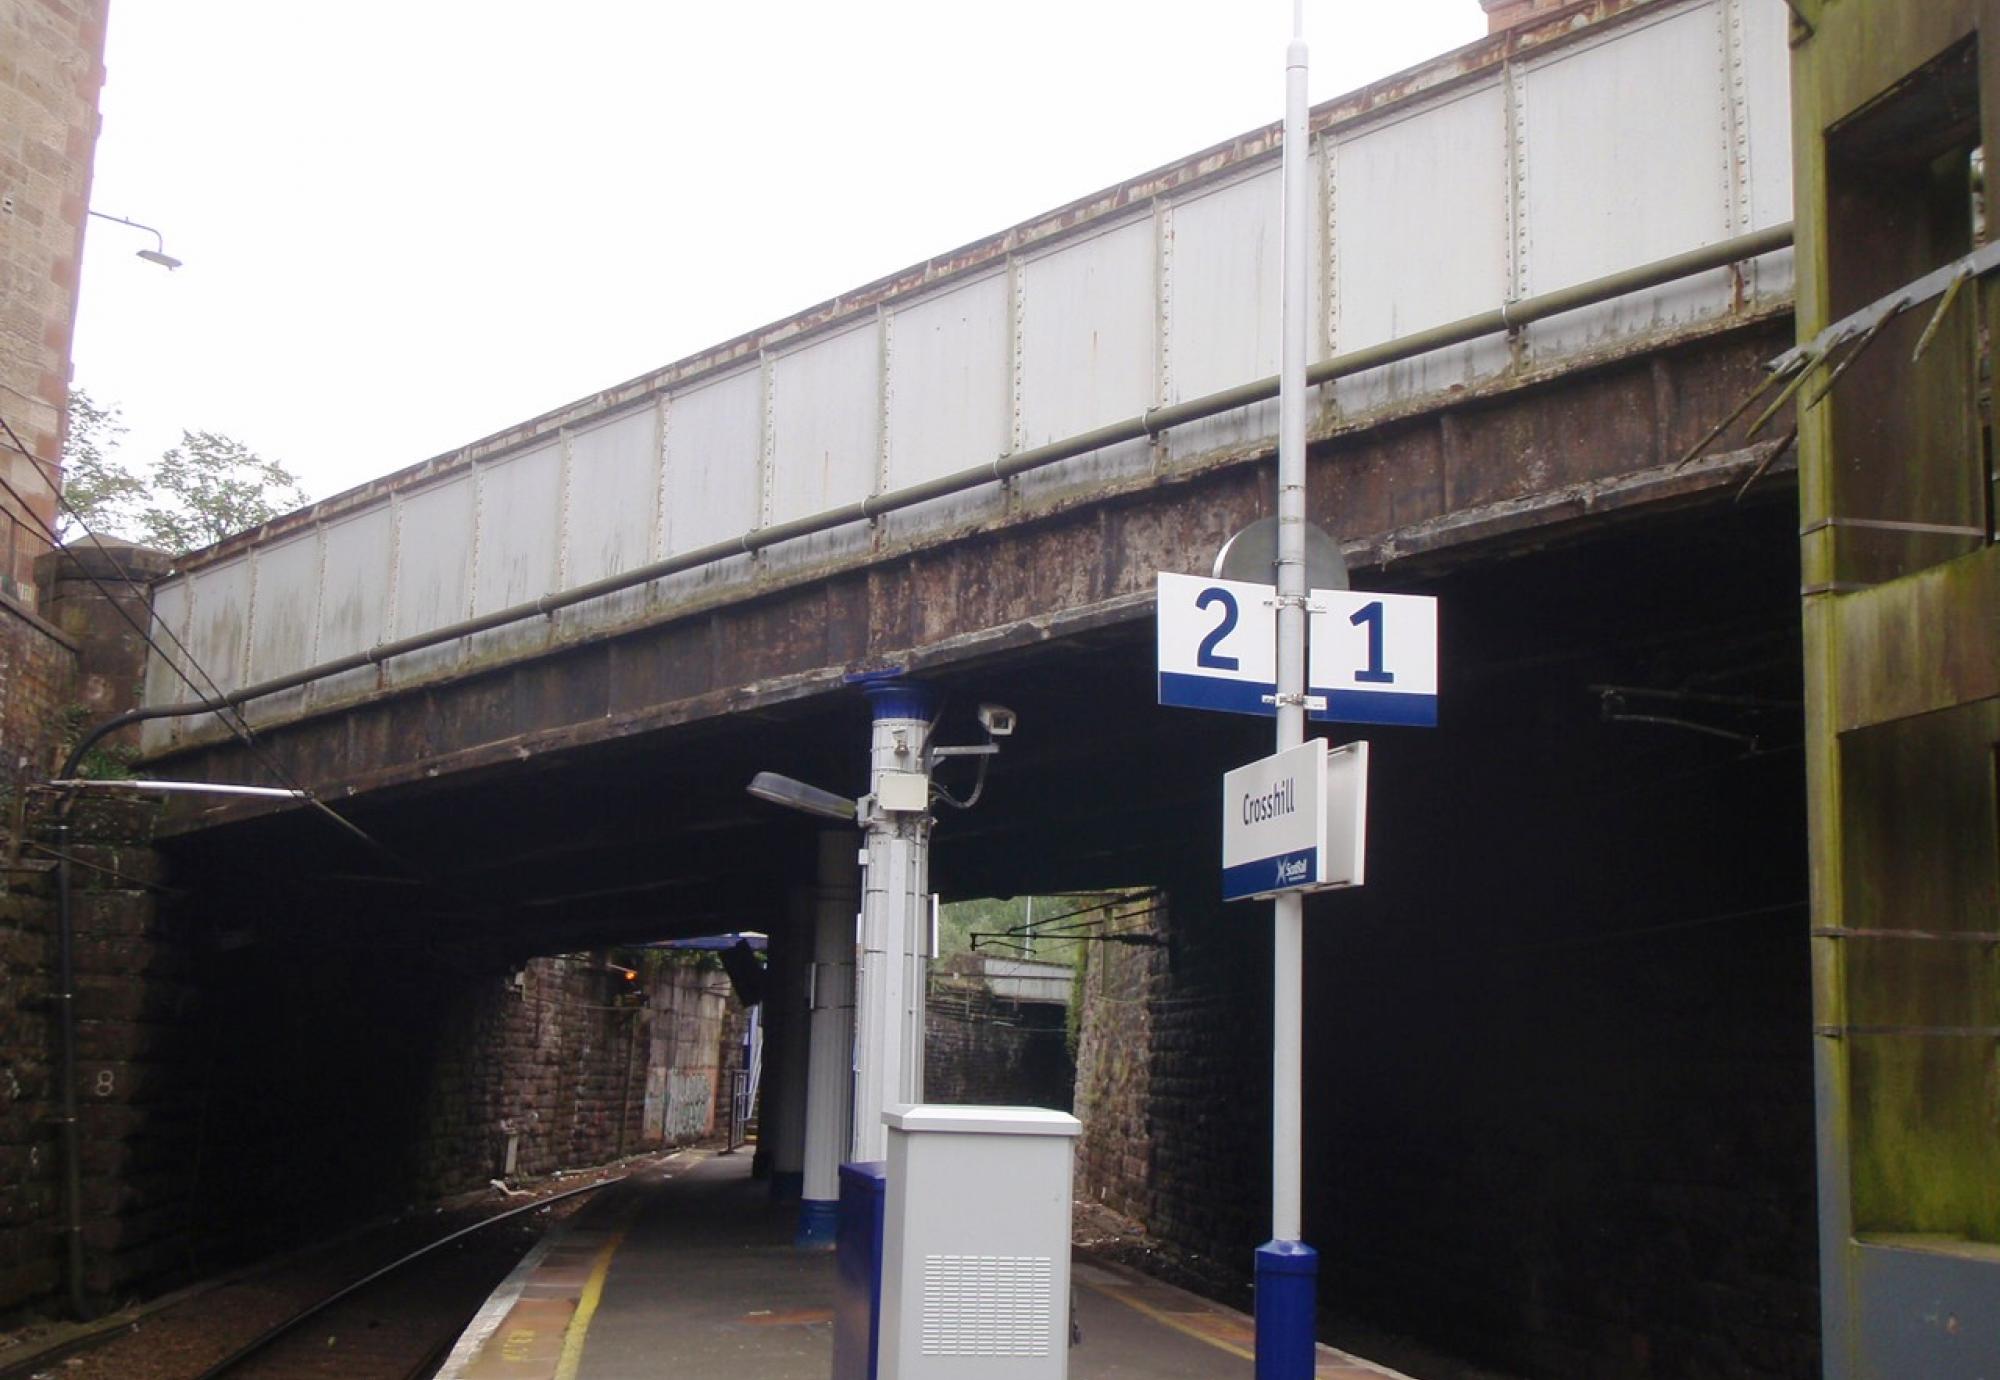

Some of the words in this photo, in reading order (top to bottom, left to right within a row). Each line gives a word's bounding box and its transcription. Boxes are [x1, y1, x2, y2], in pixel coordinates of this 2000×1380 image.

[1195, 587, 1239, 671] 2
[1350, 601, 1394, 684] 1
[1243, 776, 1295, 825] Crosshill
[95, 1070, 114, 1097] 8
